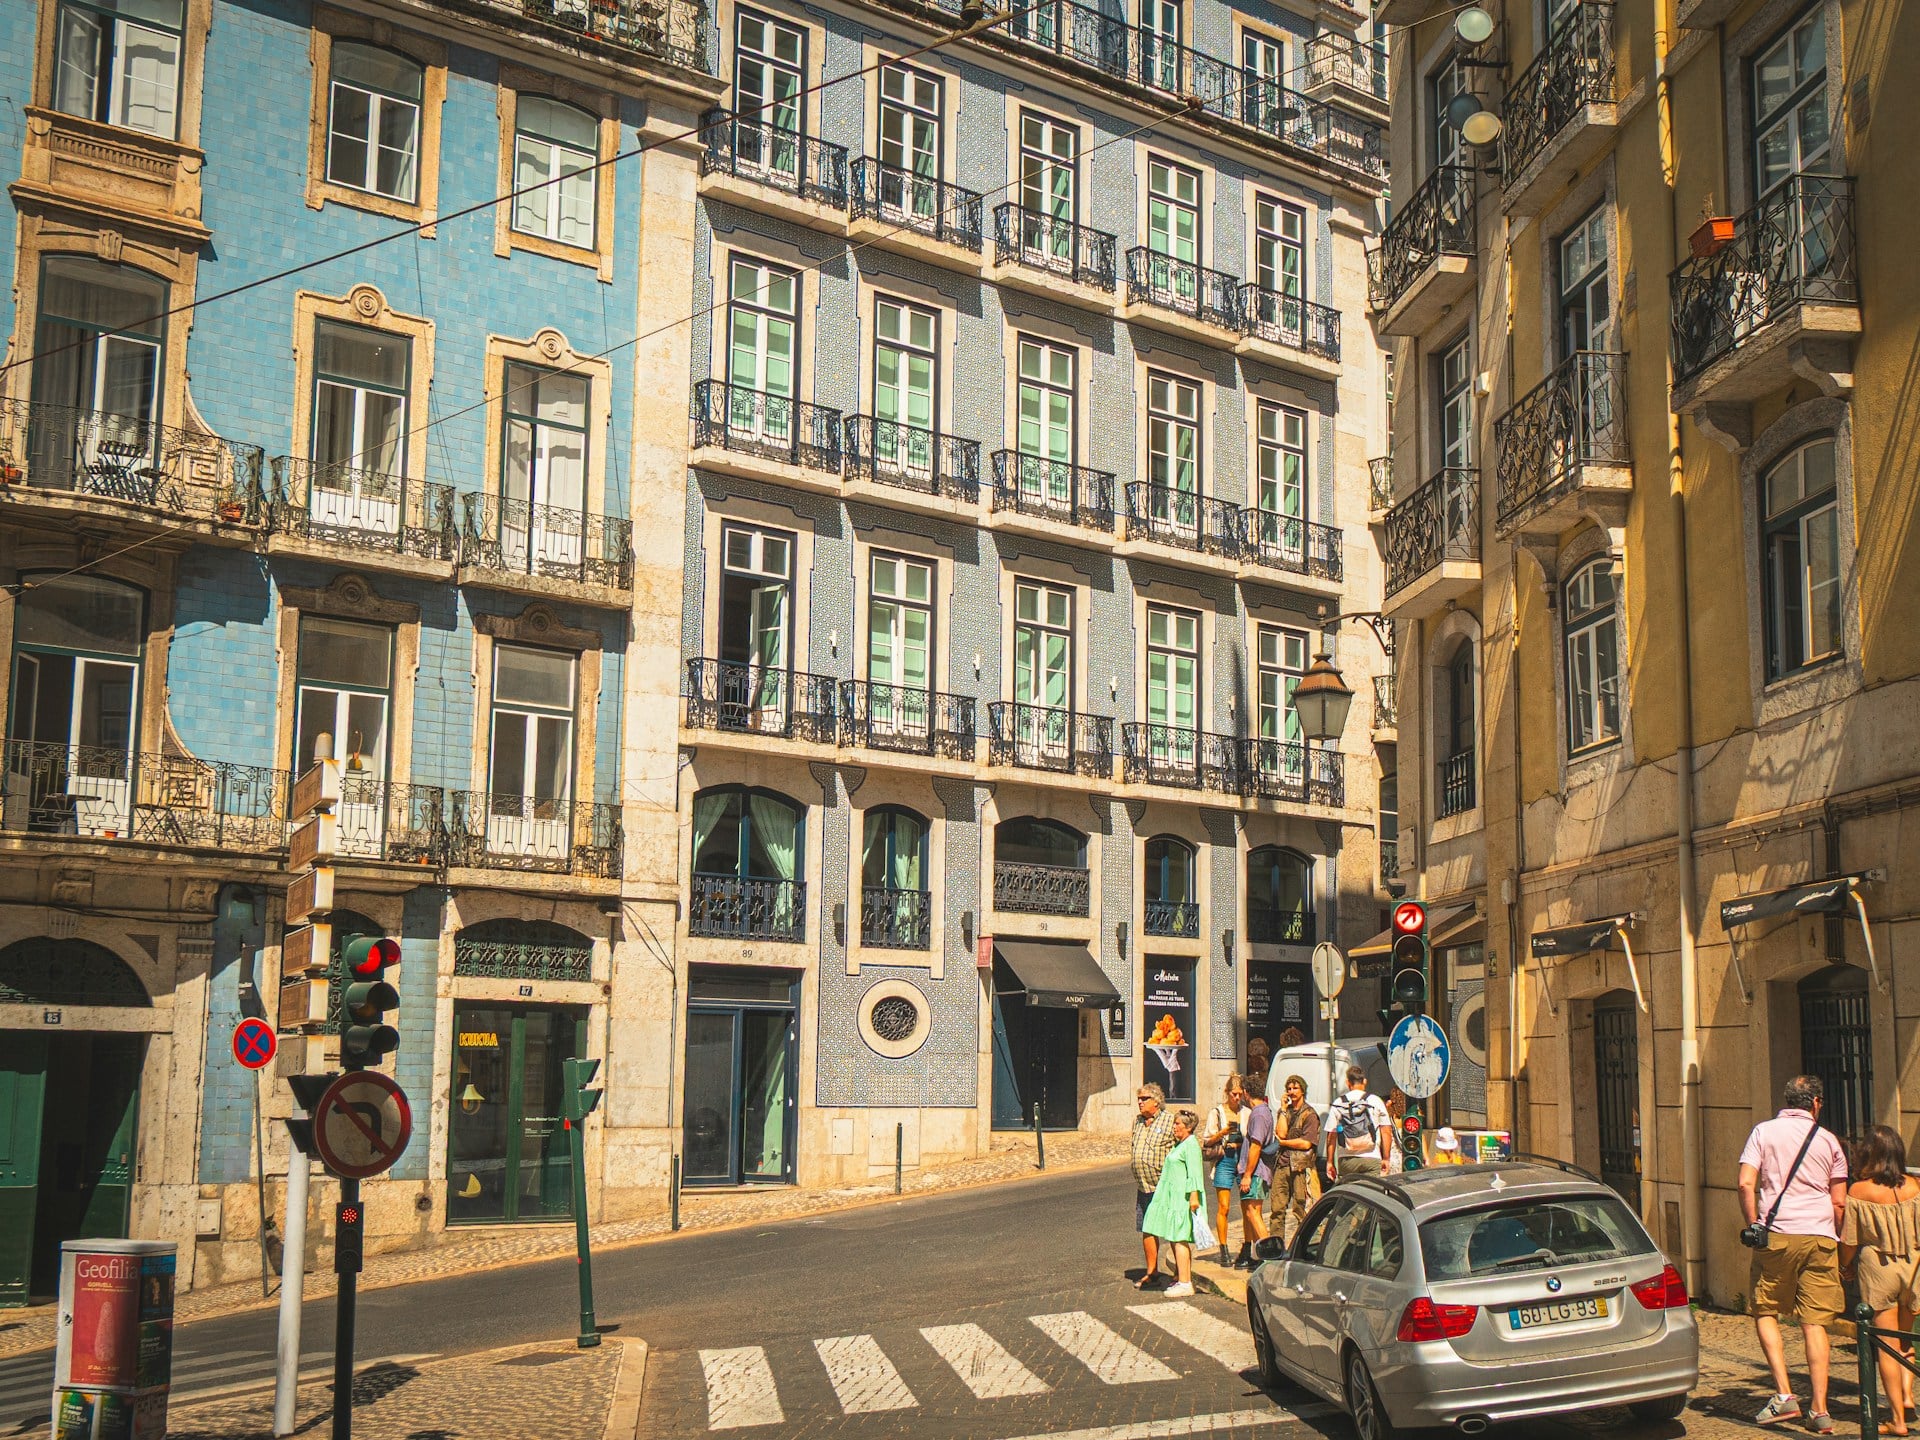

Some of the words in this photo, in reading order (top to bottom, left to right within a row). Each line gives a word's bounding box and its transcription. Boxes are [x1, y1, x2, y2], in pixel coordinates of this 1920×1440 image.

[1041, 922, 1048, 931] 91
[742, 949, 753, 959] 89
[521, 986, 531, 996] 87
[47, 1013, 59, 1024] 85
[459, 1032, 498, 1047] KUKUA
[77, 1259, 138, 1279] Geofilia
